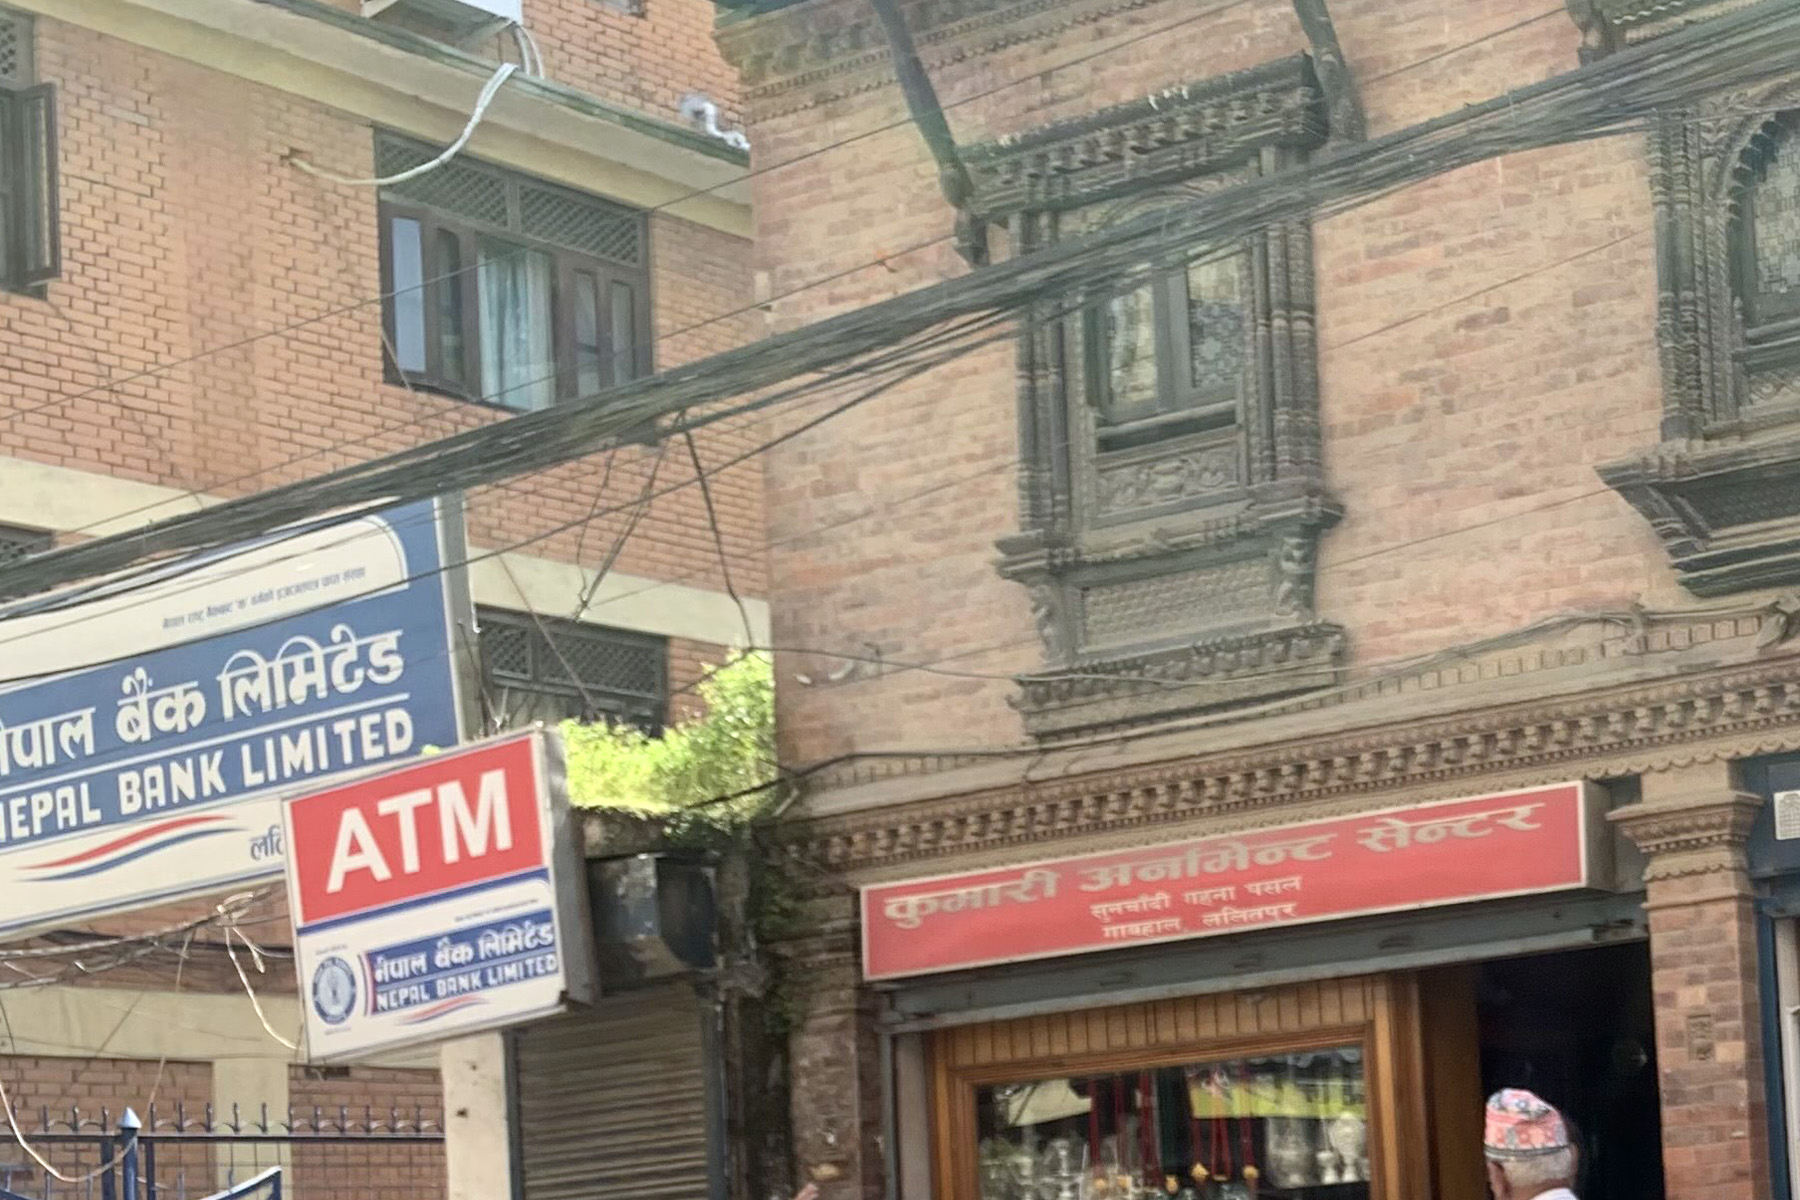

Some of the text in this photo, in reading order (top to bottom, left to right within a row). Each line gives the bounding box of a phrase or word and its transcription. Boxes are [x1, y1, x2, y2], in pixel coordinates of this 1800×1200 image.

[116, 666, 206, 743] बैंक
[216, 623, 404, 722] लिमिटेड
[118, 749, 226, 816] BANK
[241, 707, 413, 787] LIMITED
[326, 767, 512, 894] ATM
[884, 868, 1061, 929] कुमारी
[1356, 803, 1546, 852] सेन्टर
[1182, 886, 1236, 906] गहना
[1244, 876, 1302, 896] पसल
[375, 952, 429, 983] नेपाल
[478, 920, 554, 960] लिमिटेड
[376, 953, 557, 1011] NEPAL BANK LIMITED
